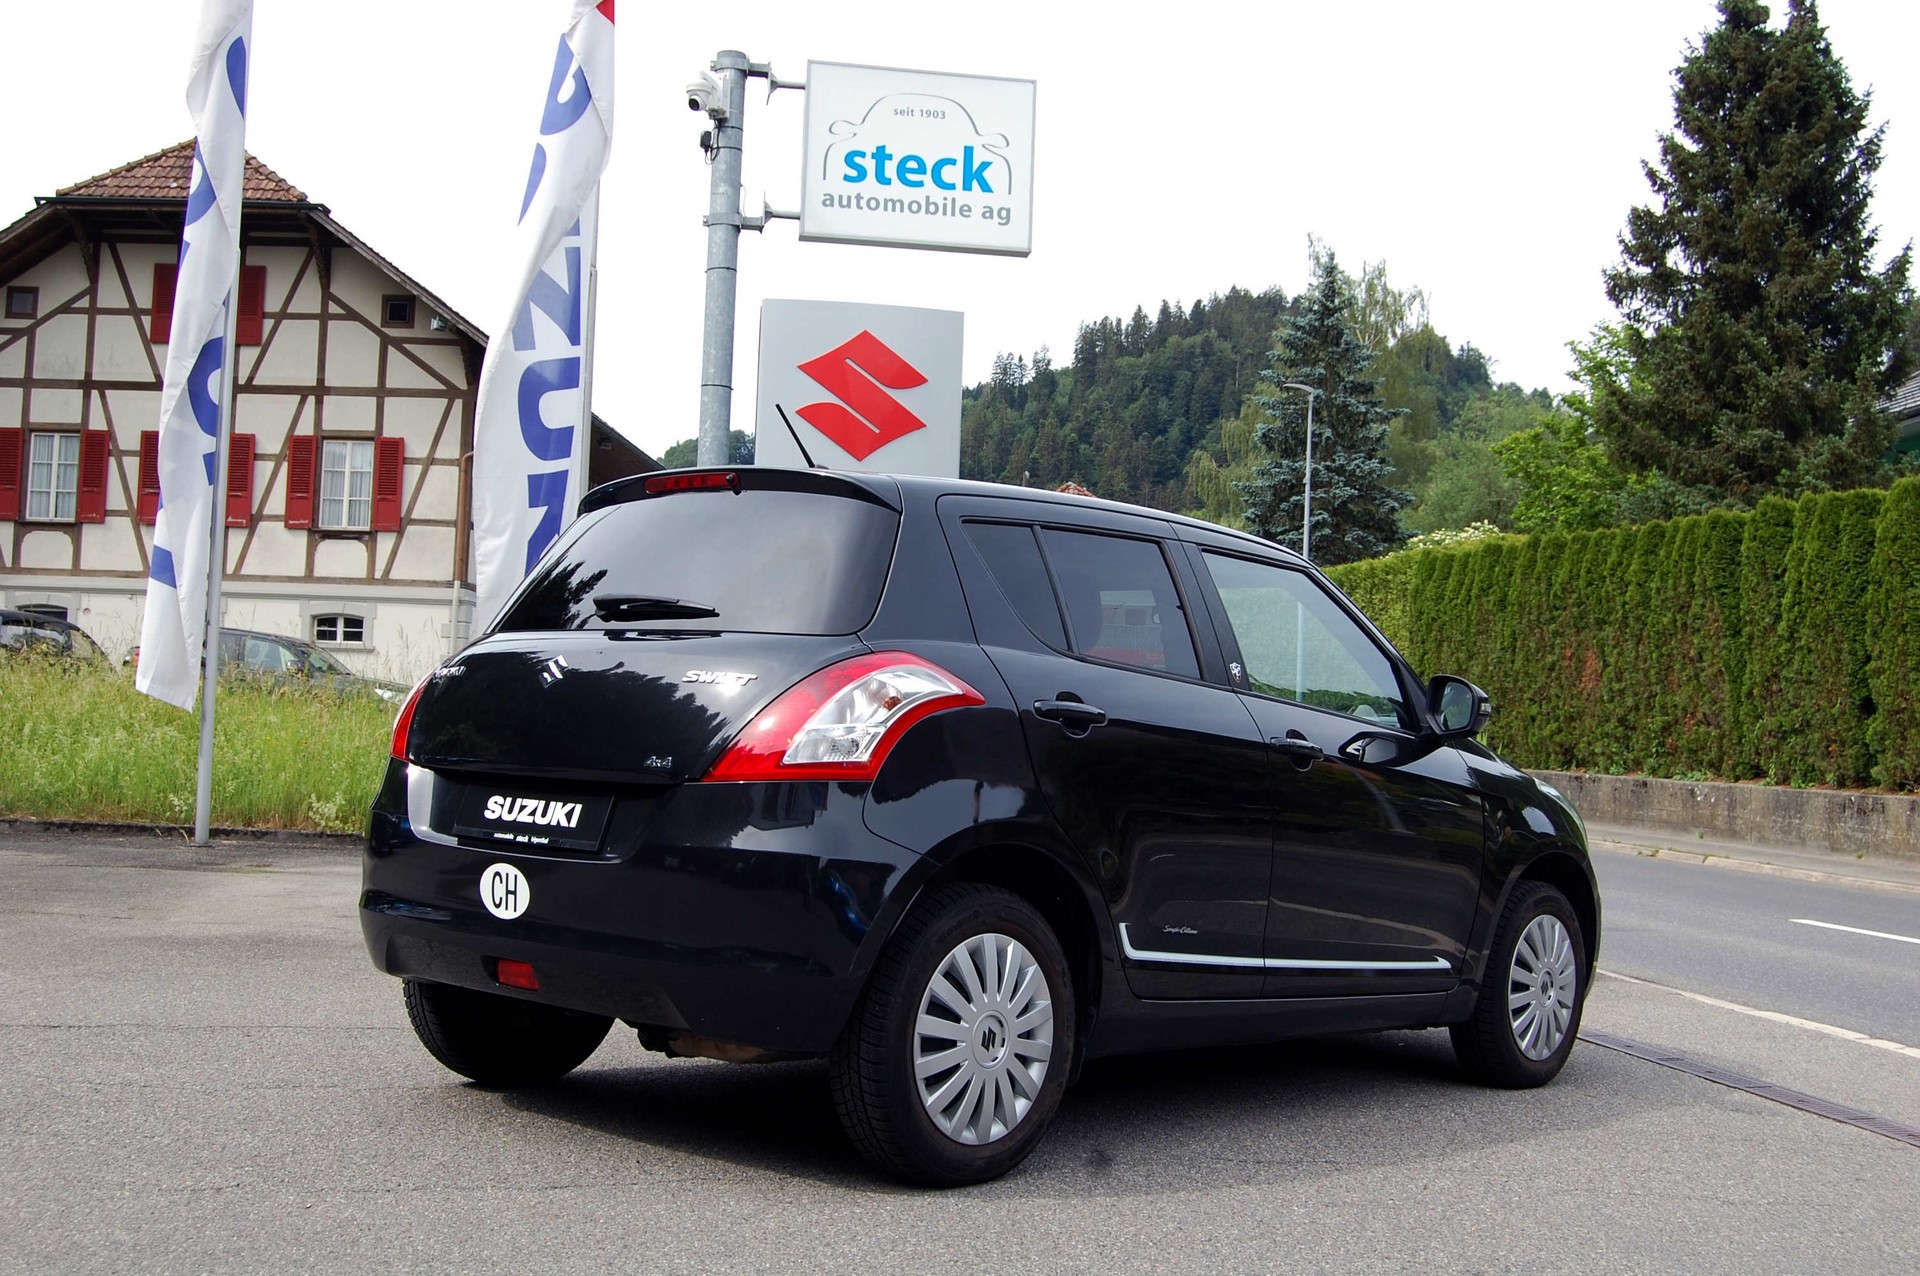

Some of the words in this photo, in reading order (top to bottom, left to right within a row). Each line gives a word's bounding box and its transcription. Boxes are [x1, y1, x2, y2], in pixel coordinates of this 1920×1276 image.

[893, 107, 915, 117] seit
[919, 108, 946, 120] 1903
[843, 145, 994, 193] steck
[821, 192, 972, 218] automobile
[981, 205, 1012, 226] ag
[483, 795, 583, 829] SUZUKI
[491, 871, 518, 913] CH
